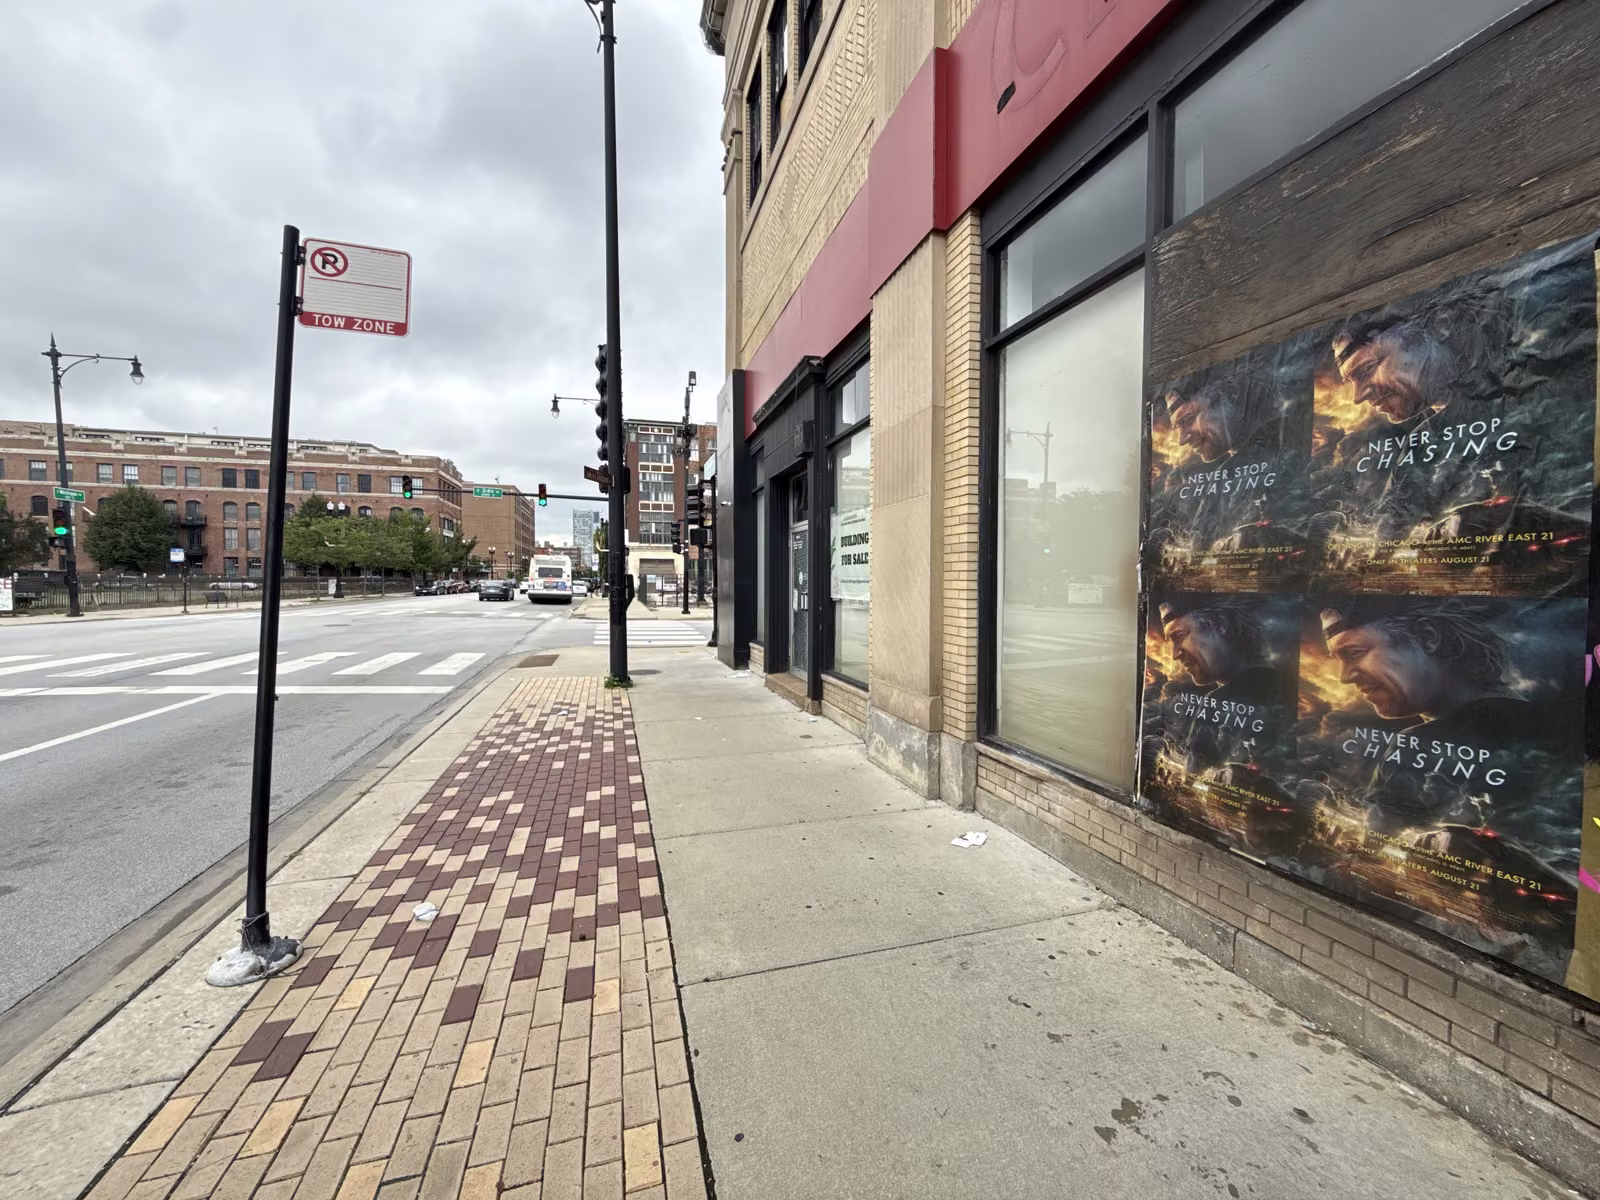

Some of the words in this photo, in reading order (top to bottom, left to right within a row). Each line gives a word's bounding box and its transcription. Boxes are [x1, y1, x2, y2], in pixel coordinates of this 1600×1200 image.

[312, 314, 346, 328] TOW
[352, 318, 395, 334] ZONE
[1368, 431, 1430, 454] NEVER
[1443, 418, 1501, 441] STOP
[1356, 432, 1518, 473] CHASING
[1188, 469, 1228, 485] NEVER
[1234, 462, 1268, 478] STOP
[1179, 473, 1276, 499] CHASING
[841, 532, 869, 548] BUILDING
[1378, 538, 1421, 548] CHICAGO
[1448, 536, 1472, 546] AMC
[1475, 534, 1504, 544] RIVER
[1508, 532, 1538, 542] EAST
[1541, 532, 1554, 541] 21
[842, 554, 852, 566] FOR
[853, 552, 869, 566] SALE
[1440, 556, 1478, 564] AUGUST
[1181, 693, 1217, 708] NEVER
[1222, 701, 1255, 716] STOP
[1174, 702, 1264, 732] CHASING
[1355, 727, 1420, 750] NEVER
[1431, 740, 1490, 764] STOP
[1342, 739, 1507, 786] CHASING
[1256, 793, 1271, 804] EAST
[1356, 844, 1376, 856] ONLY
[1430, 868, 1468, 886] AUGUST
[1470, 882, 1480, 891] 21
[1368, 830, 1409, 848] CHICAGO
[1436, 852, 1462, 865] AMC
[1464, 860, 1493, 876] RIVER
[1496, 870, 1526, 886] EAST
[1529, 880, 1542, 891] 21
